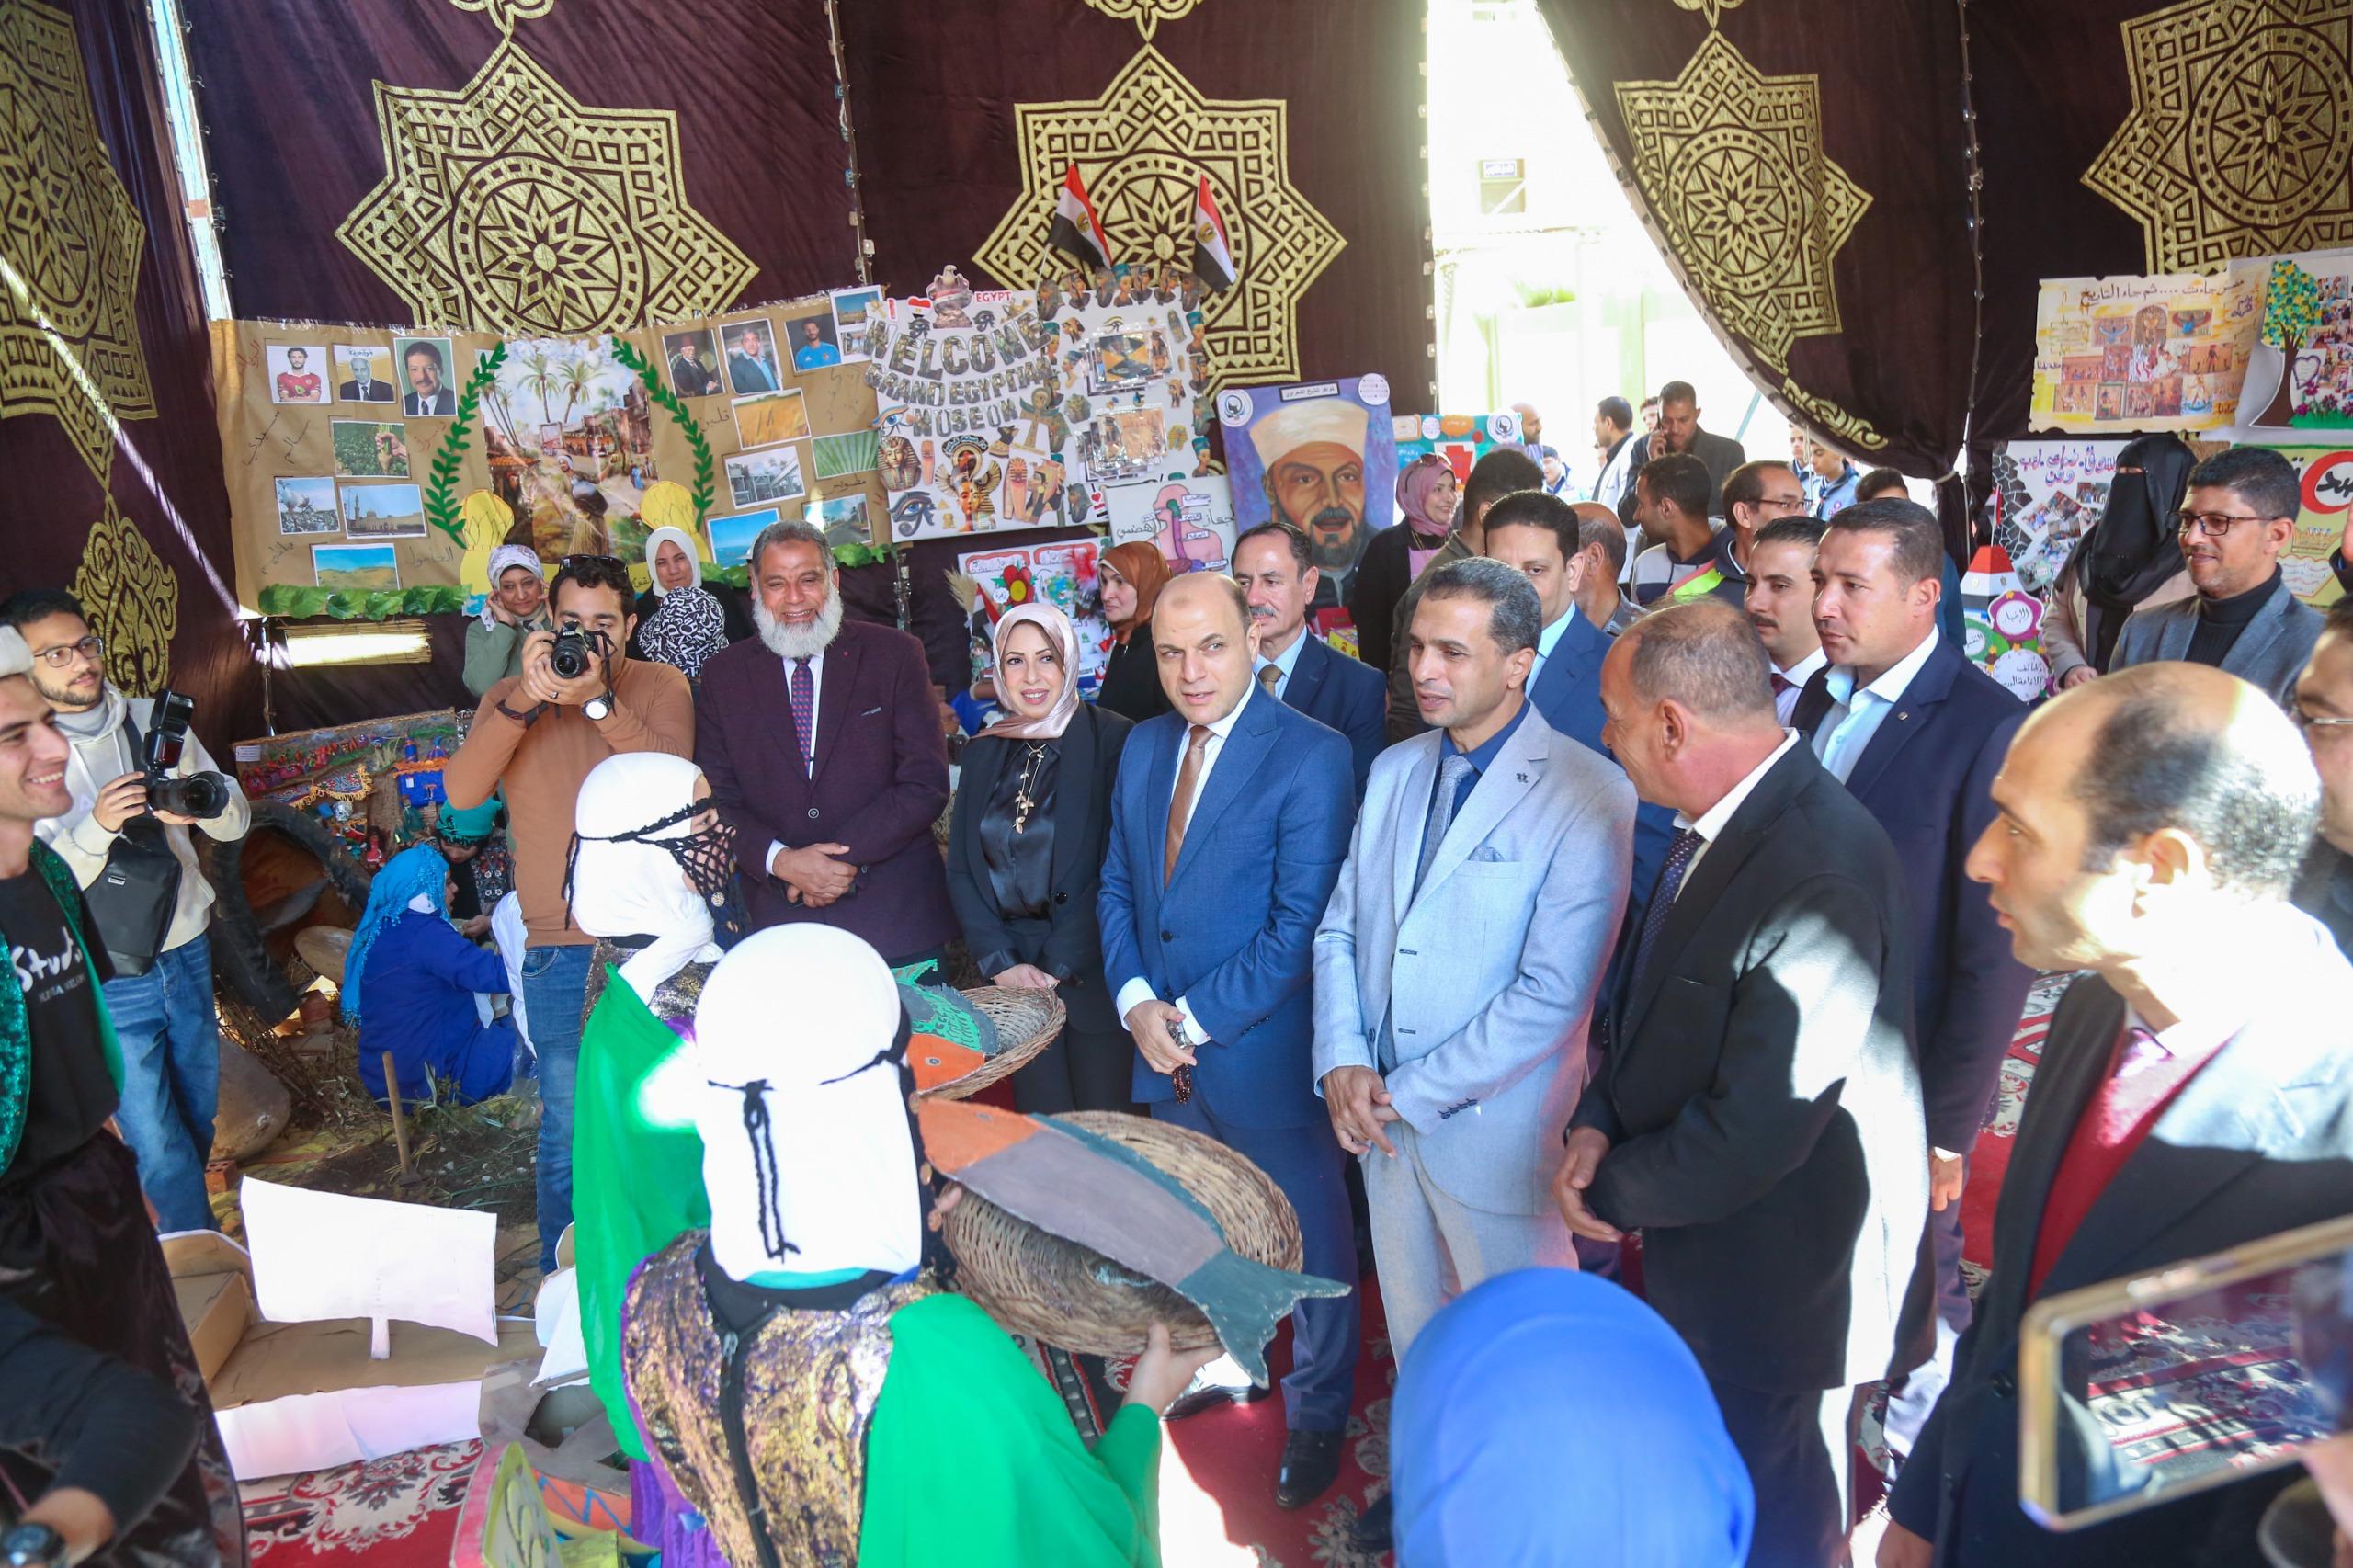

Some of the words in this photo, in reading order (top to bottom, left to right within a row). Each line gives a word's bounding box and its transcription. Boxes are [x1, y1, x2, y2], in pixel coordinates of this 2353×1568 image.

[975, 291, 1011, 302] EGYPT
[863, 312, 1052, 381] WELCOME
[865, 364, 946, 407] GRAND
[949, 356, 1055, 405] EGYPTIAN
[913, 398, 1018, 437] MUSEUM
